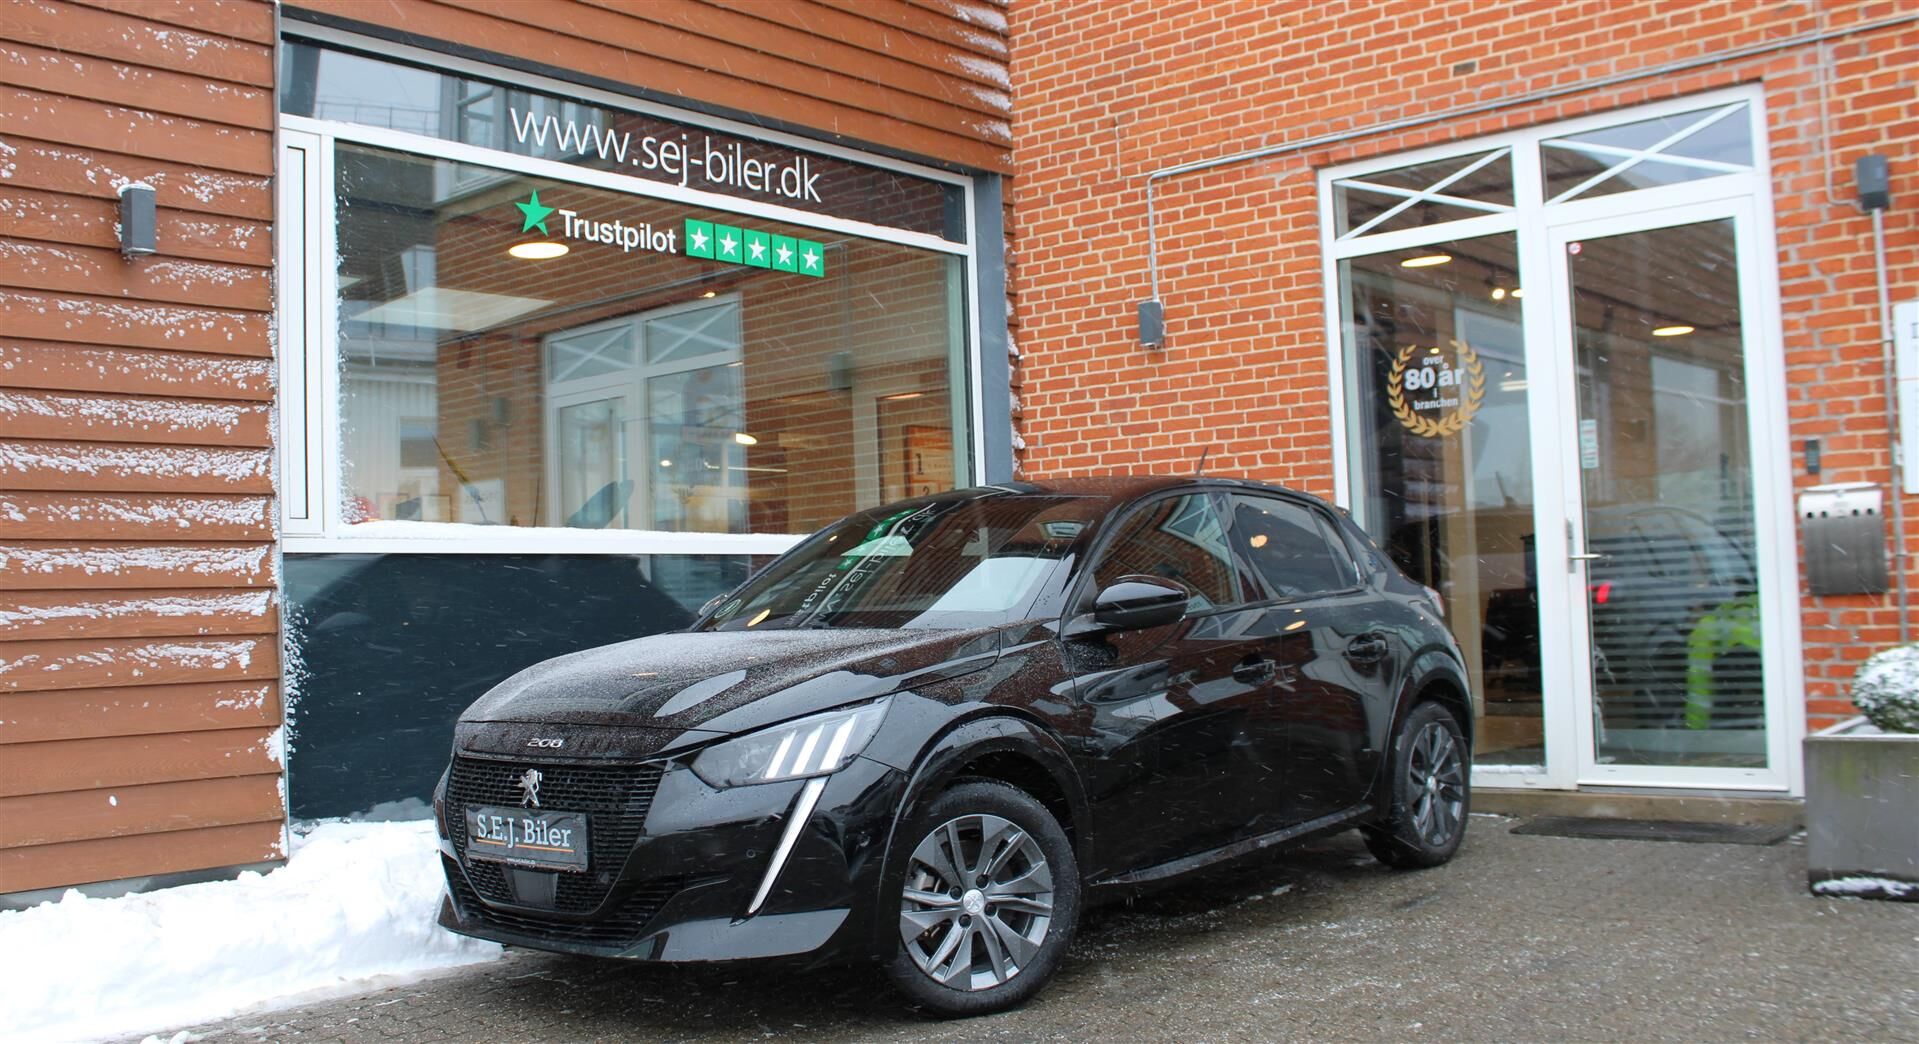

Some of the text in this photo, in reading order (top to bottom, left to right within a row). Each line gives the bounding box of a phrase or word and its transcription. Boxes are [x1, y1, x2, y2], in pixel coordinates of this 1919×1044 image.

[510, 107, 821, 202] www.sej-biler.dk
[559, 210, 676, 253] Trustpilot
[1423, 355, 1444, 365] over
[1405, 363, 1465, 390] 80 år
[1414, 398, 1459, 410] branchen
[527, 738, 563, 748] 208
[477, 814, 571, 848] S.E.J. Biler
